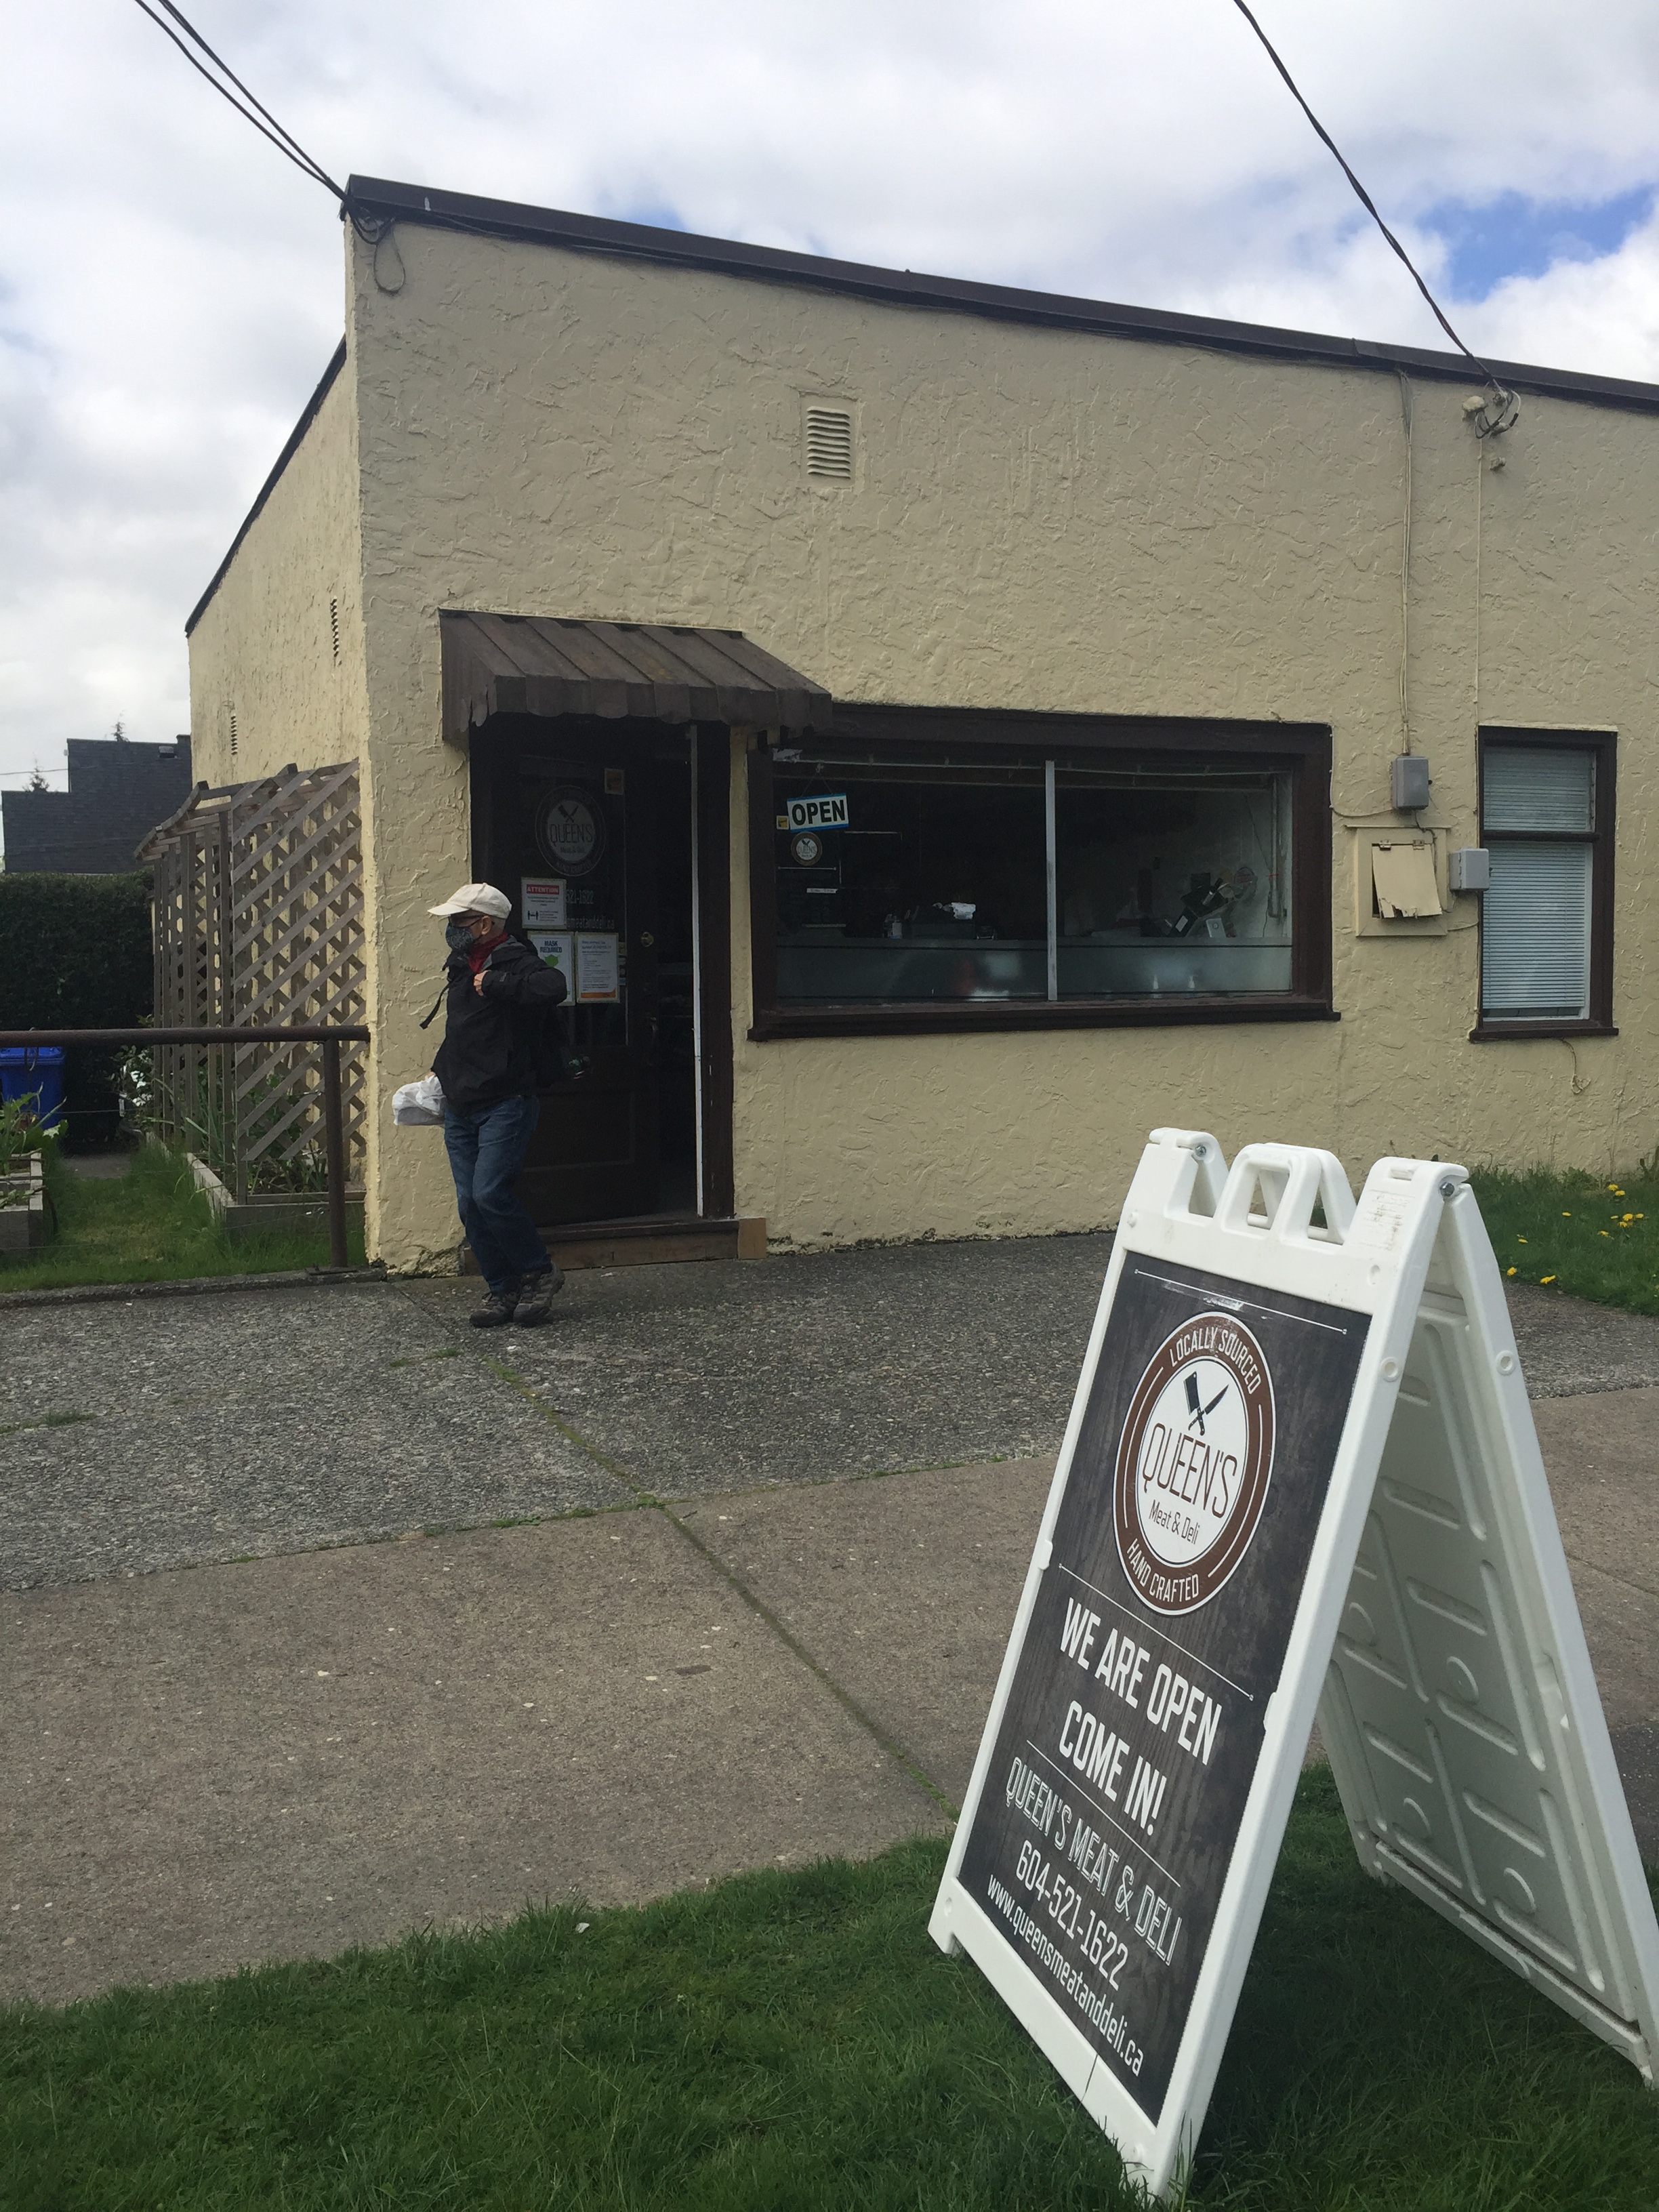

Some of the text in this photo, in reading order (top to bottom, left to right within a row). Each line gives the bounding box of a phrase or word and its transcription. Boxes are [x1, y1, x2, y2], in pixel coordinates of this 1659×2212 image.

[792, 800, 846, 825] OPEN
[1169, 1326, 1261, 1395] LOCALLY SOURCED
[1142, 1422, 1237, 1519] QUEEN'S
[1149, 1499, 1200, 1545] Meat & Deli
[1126, 1538, 1200, 1603] HAND CRAFTED
[1060, 1597, 1223, 1766] WE ARE OPEN
[1059, 1700, 1167, 1836] COME IN!
[1005, 1756, 1183, 1966] QUEEN'S MEAT & DELI
[1016, 1839, 1129, 1991] 604-521-1622
[987, 1874, 1145, 2077] www.queensmeatanddeli.ca
